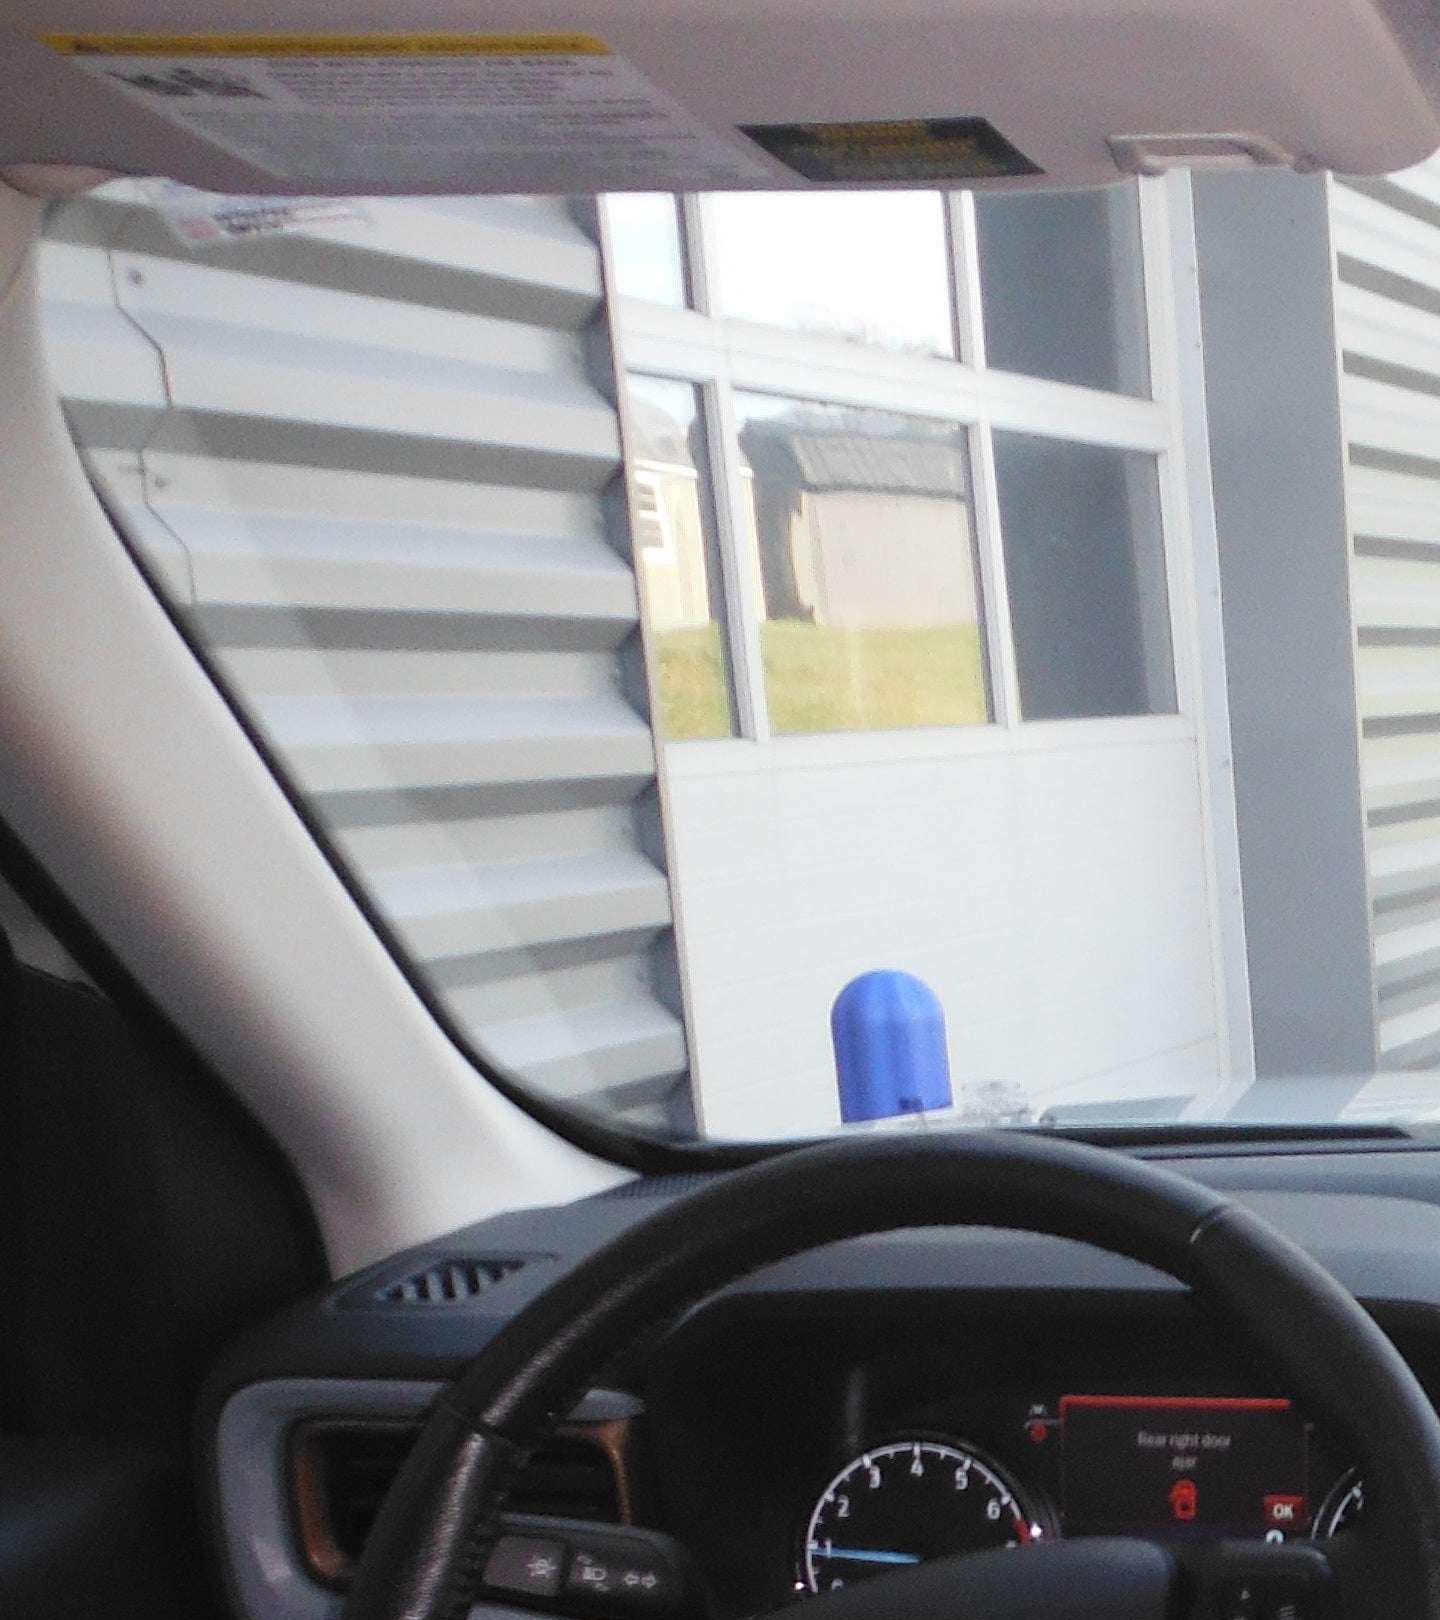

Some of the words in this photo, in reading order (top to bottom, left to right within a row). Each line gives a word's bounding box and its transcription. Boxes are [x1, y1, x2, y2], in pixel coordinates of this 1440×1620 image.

[868, 1465, 881, 1489] 3
[910, 1458, 925, 1477] 4
[954, 1469, 969, 1490] 5
[837, 1494, 850, 1518] 2
[986, 1499, 1001, 1520] 6
[1272, 1503, 1295, 1520] OK
